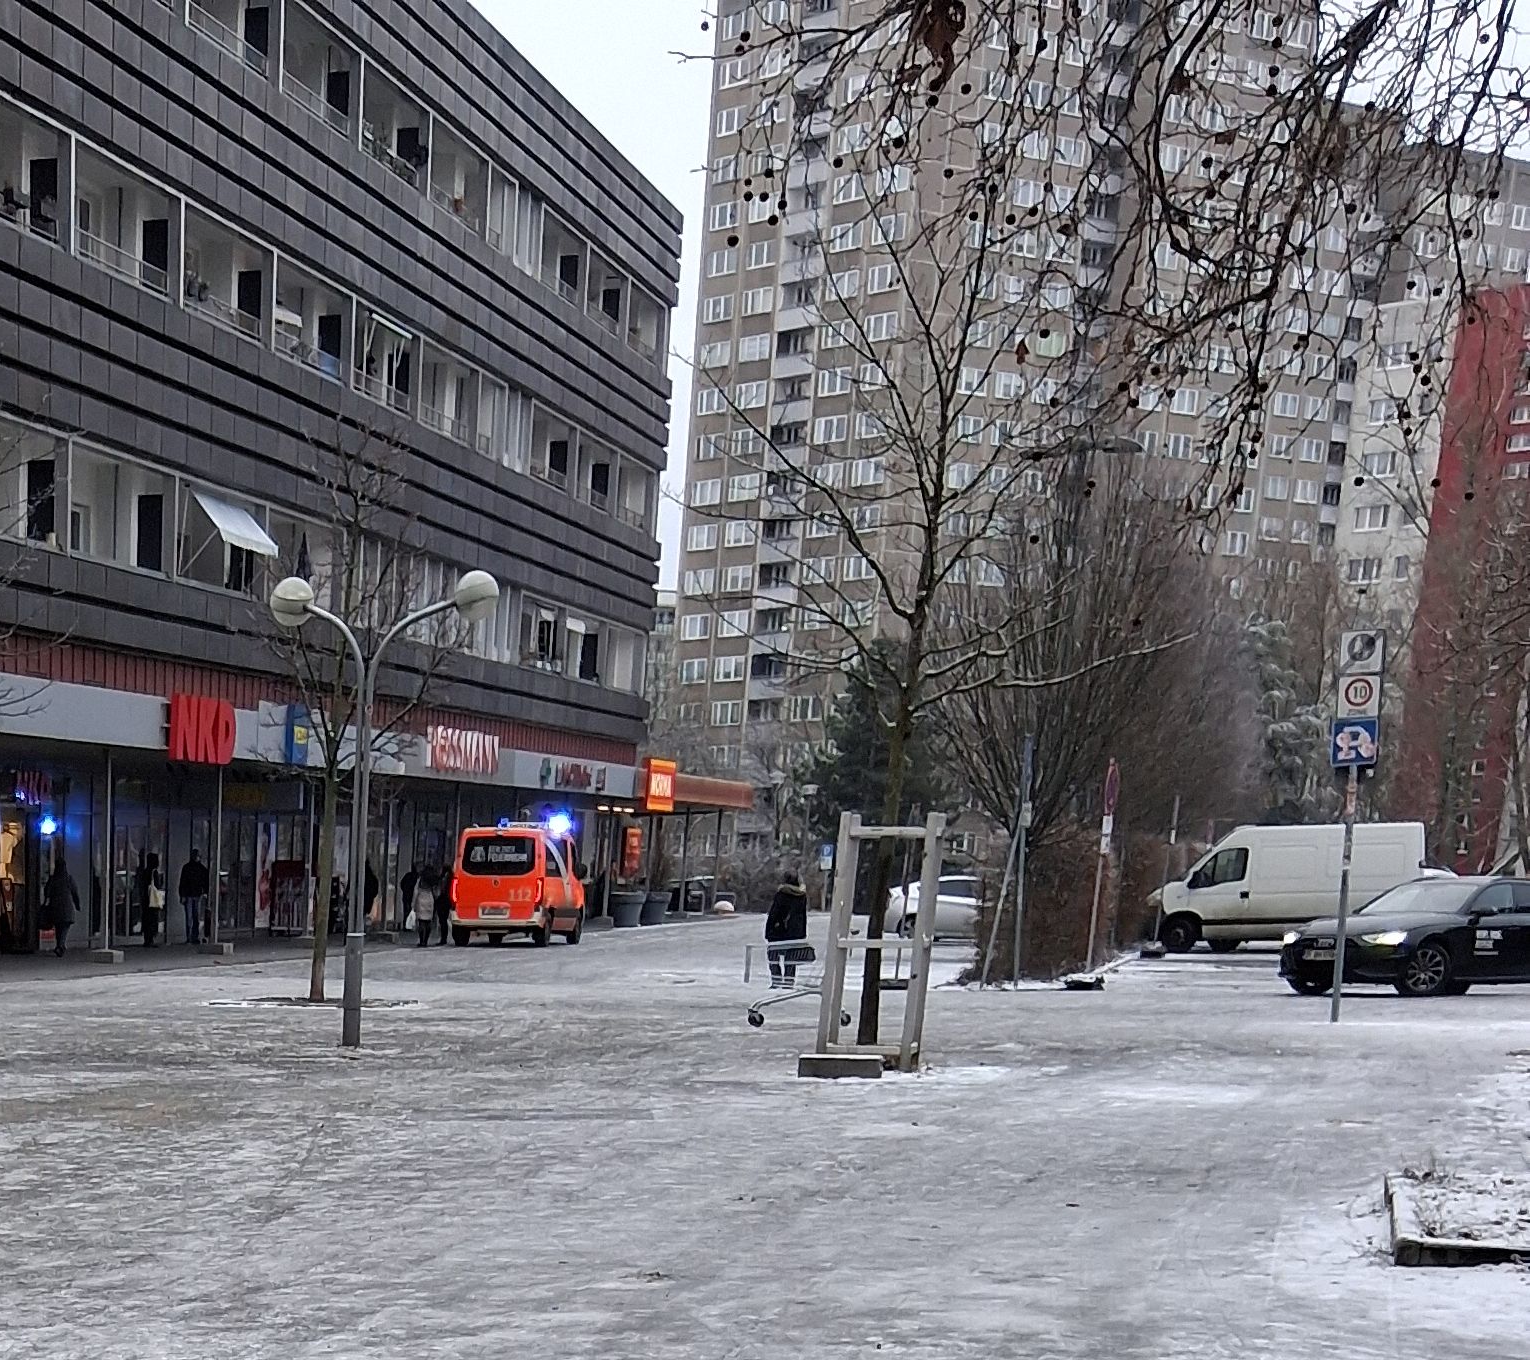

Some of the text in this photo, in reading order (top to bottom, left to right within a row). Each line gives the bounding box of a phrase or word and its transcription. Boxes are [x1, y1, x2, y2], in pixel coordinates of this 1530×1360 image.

[1353, 685, 1368, 700] 10
[169, 693, 236, 764] NKD
[509, 889, 532, 902] 112
